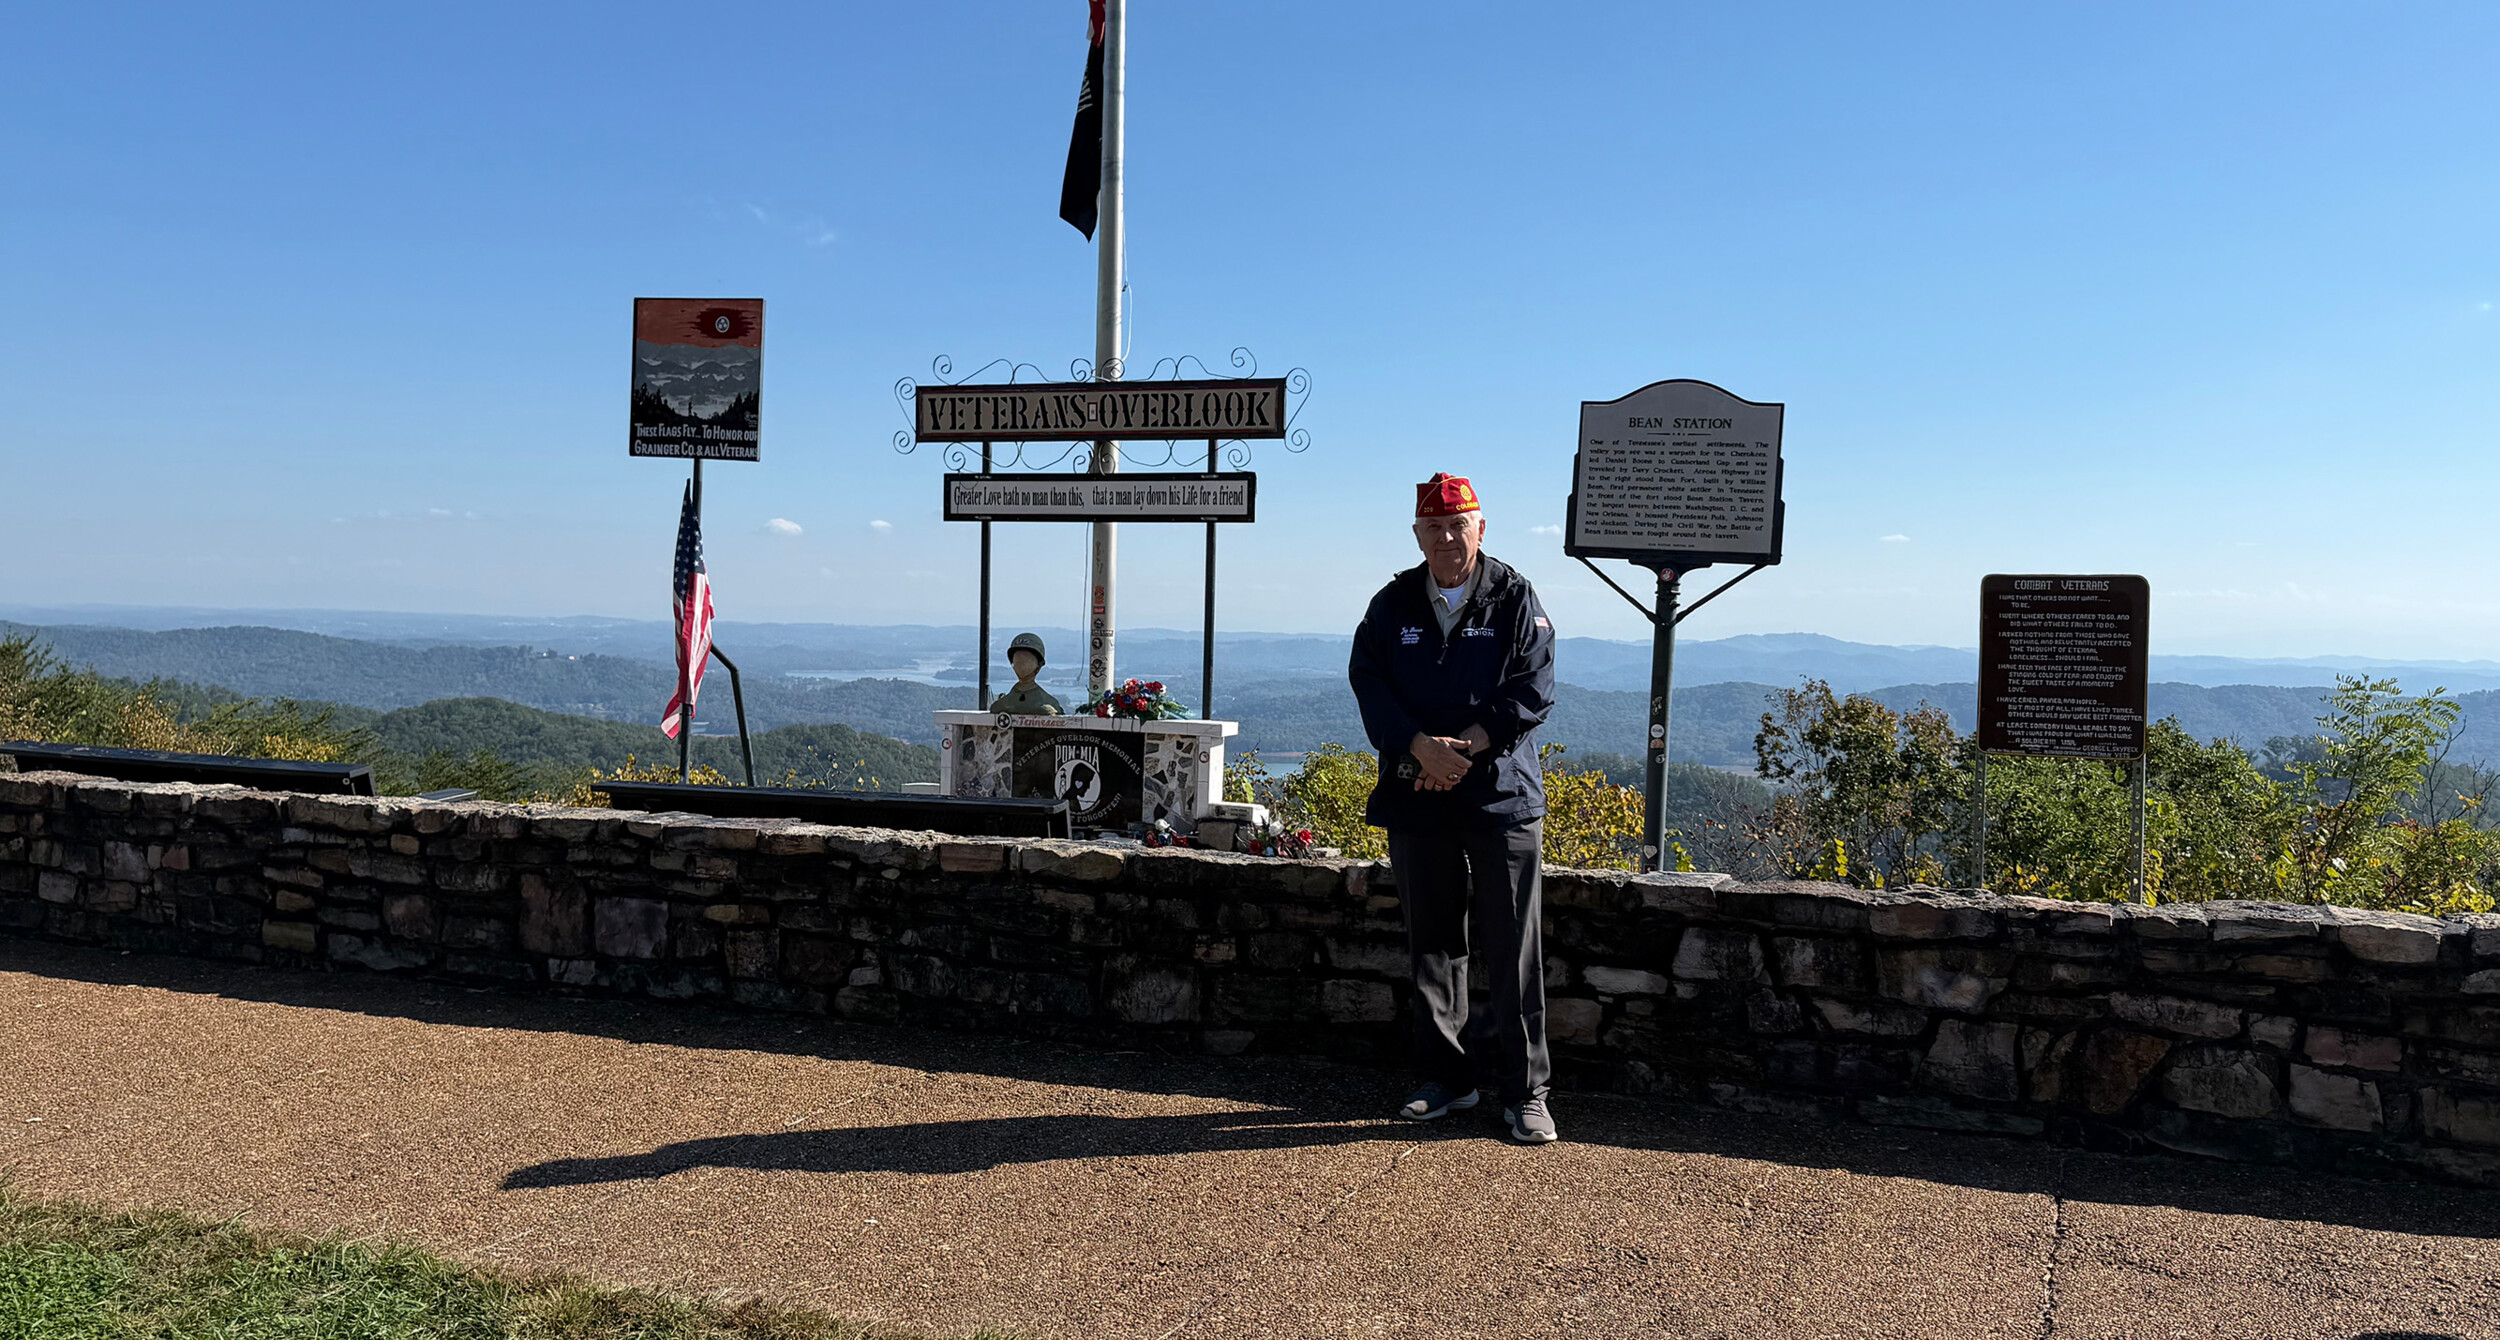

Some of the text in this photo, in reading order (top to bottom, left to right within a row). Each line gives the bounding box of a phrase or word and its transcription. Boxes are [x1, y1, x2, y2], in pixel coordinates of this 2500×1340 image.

[928, 390, 1271, 432] VETERANS OVERLOOK
[634, 423, 657, 437] THESE
[659, 424, 681, 437] FLAGS
[702, 425, 712, 439] TO
[713, 426, 742, 440] HONOR
[1629, 418, 1732, 428] BEAN STATION
[635, 441, 680, 456] GRAINGER
[696, 445, 703, 456] &
[704, 446, 720, 456] ALL
[954, 486, 1243, 510] Greater Love hath no man than this, that a man lay down his Life for a friend
[2015, 580, 2109, 590] COMBAT VETERANS
[1016, 734, 1140, 775] VETERANS OVERLOOK MEMORIAL
[1055, 745, 1100, 773] POW MIA
[1032, 787, 1041, 798] YO
